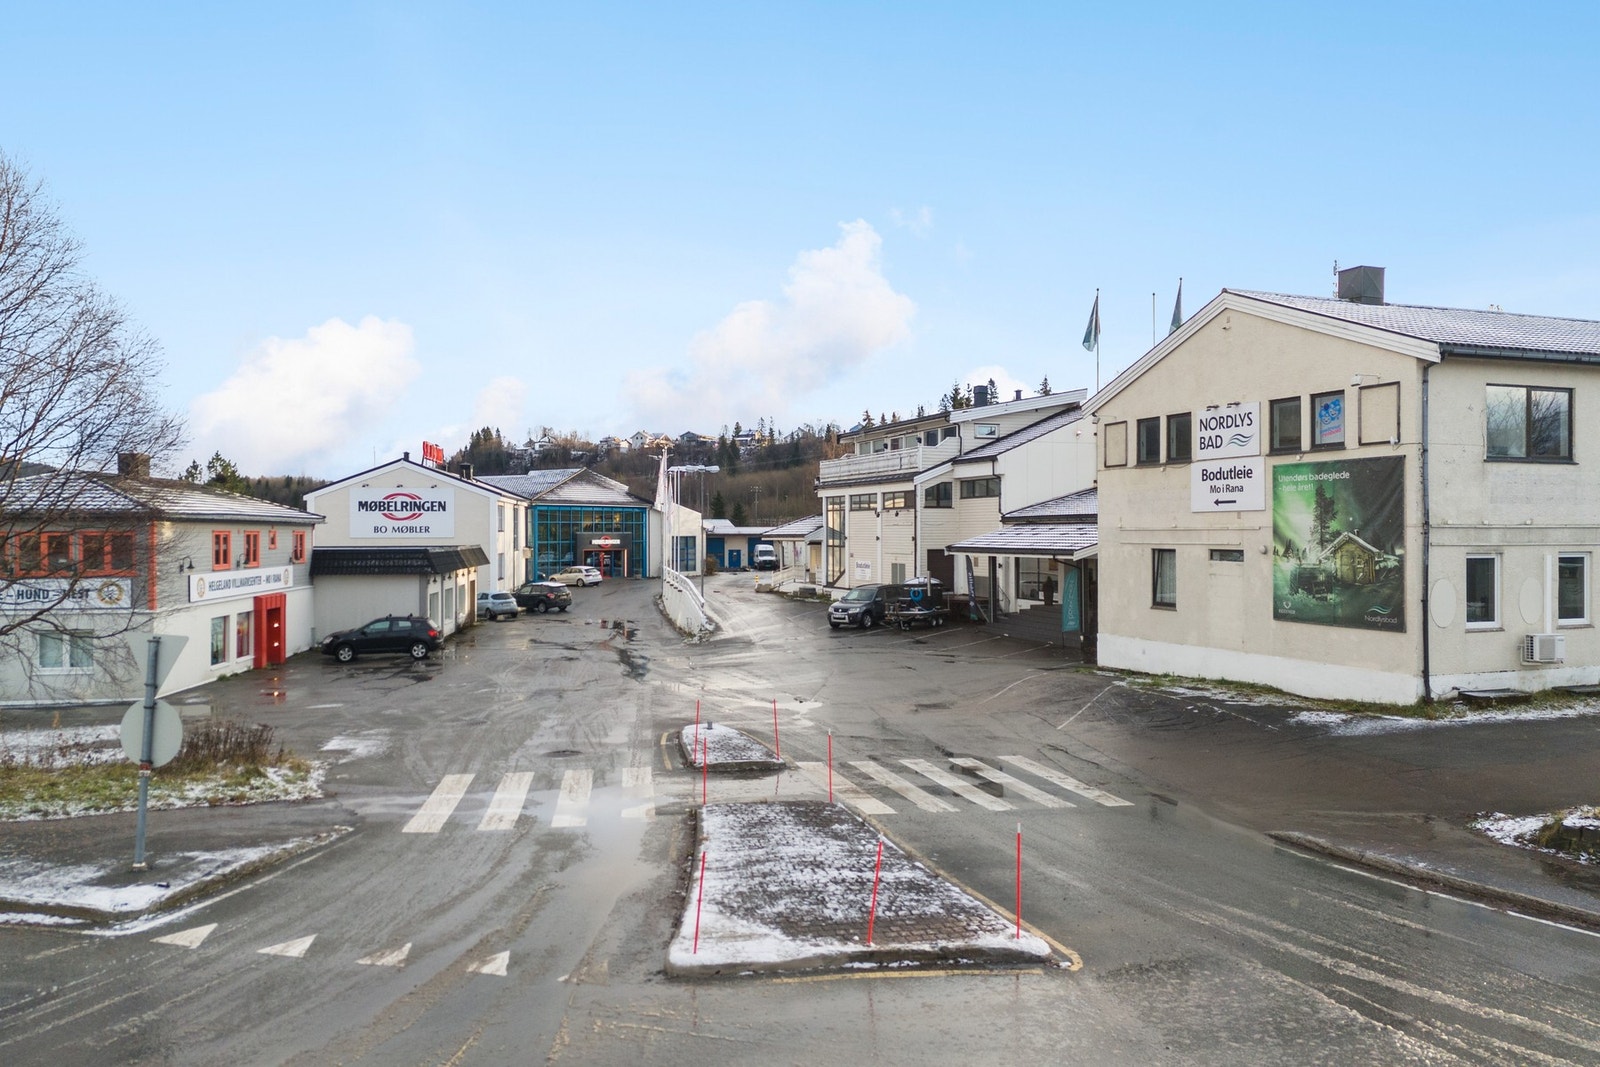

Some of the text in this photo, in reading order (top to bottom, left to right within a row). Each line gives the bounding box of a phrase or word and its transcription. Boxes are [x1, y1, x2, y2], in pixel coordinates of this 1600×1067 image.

[1199, 412, 1253, 432] NORDLYS
[1199, 434, 1223, 450] BAD
[1201, 465, 1253, 482] Bodutleie
[1309, 471, 1350, 481] badeglede
[1210, 485, 1221, 493] Mo
[1226, 485, 1243, 493] Rana
[358, 501, 446, 511] MØBELRINGEN
[208, 579, 231, 591] HELGELAND
[16, 589, 50, 600] HUND
